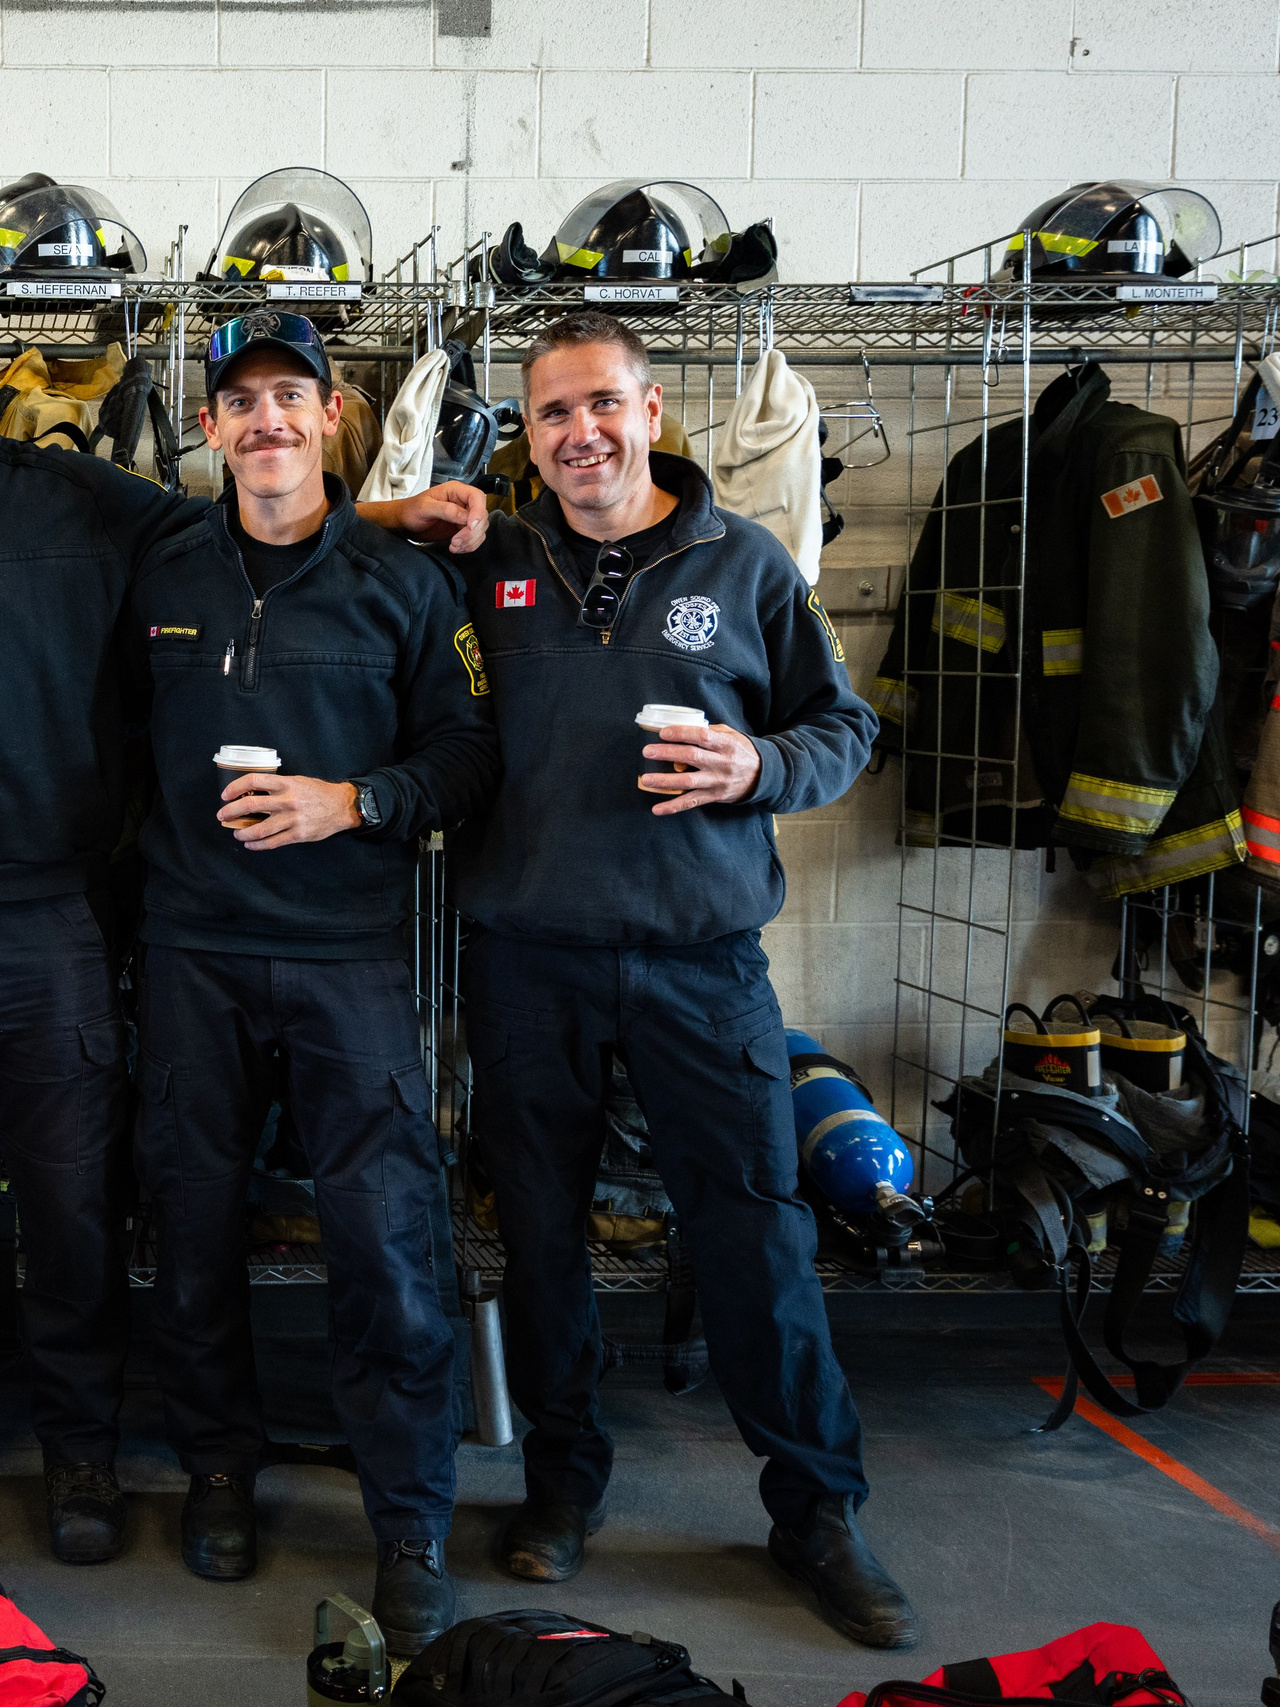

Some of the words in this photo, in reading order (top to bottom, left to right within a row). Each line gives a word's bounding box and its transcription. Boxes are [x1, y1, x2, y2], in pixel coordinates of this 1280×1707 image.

[638, 251, 660, 262] CAL
[21, 284, 32, 294] S.
[36, 284, 107, 295] HEFFERNAN
[286, 286, 296, 296] T.
[299, 286, 346, 296] REEFER
[599, 288, 611, 299] C.
[614, 288, 662, 299] HORVAT
[1131, 288, 1141, 299] L.
[1145, 288, 1203, 299] MONTEITH
[1256, 407, 1279, 427] 23
[160, 627, 197, 636] FIREFIGHTER
